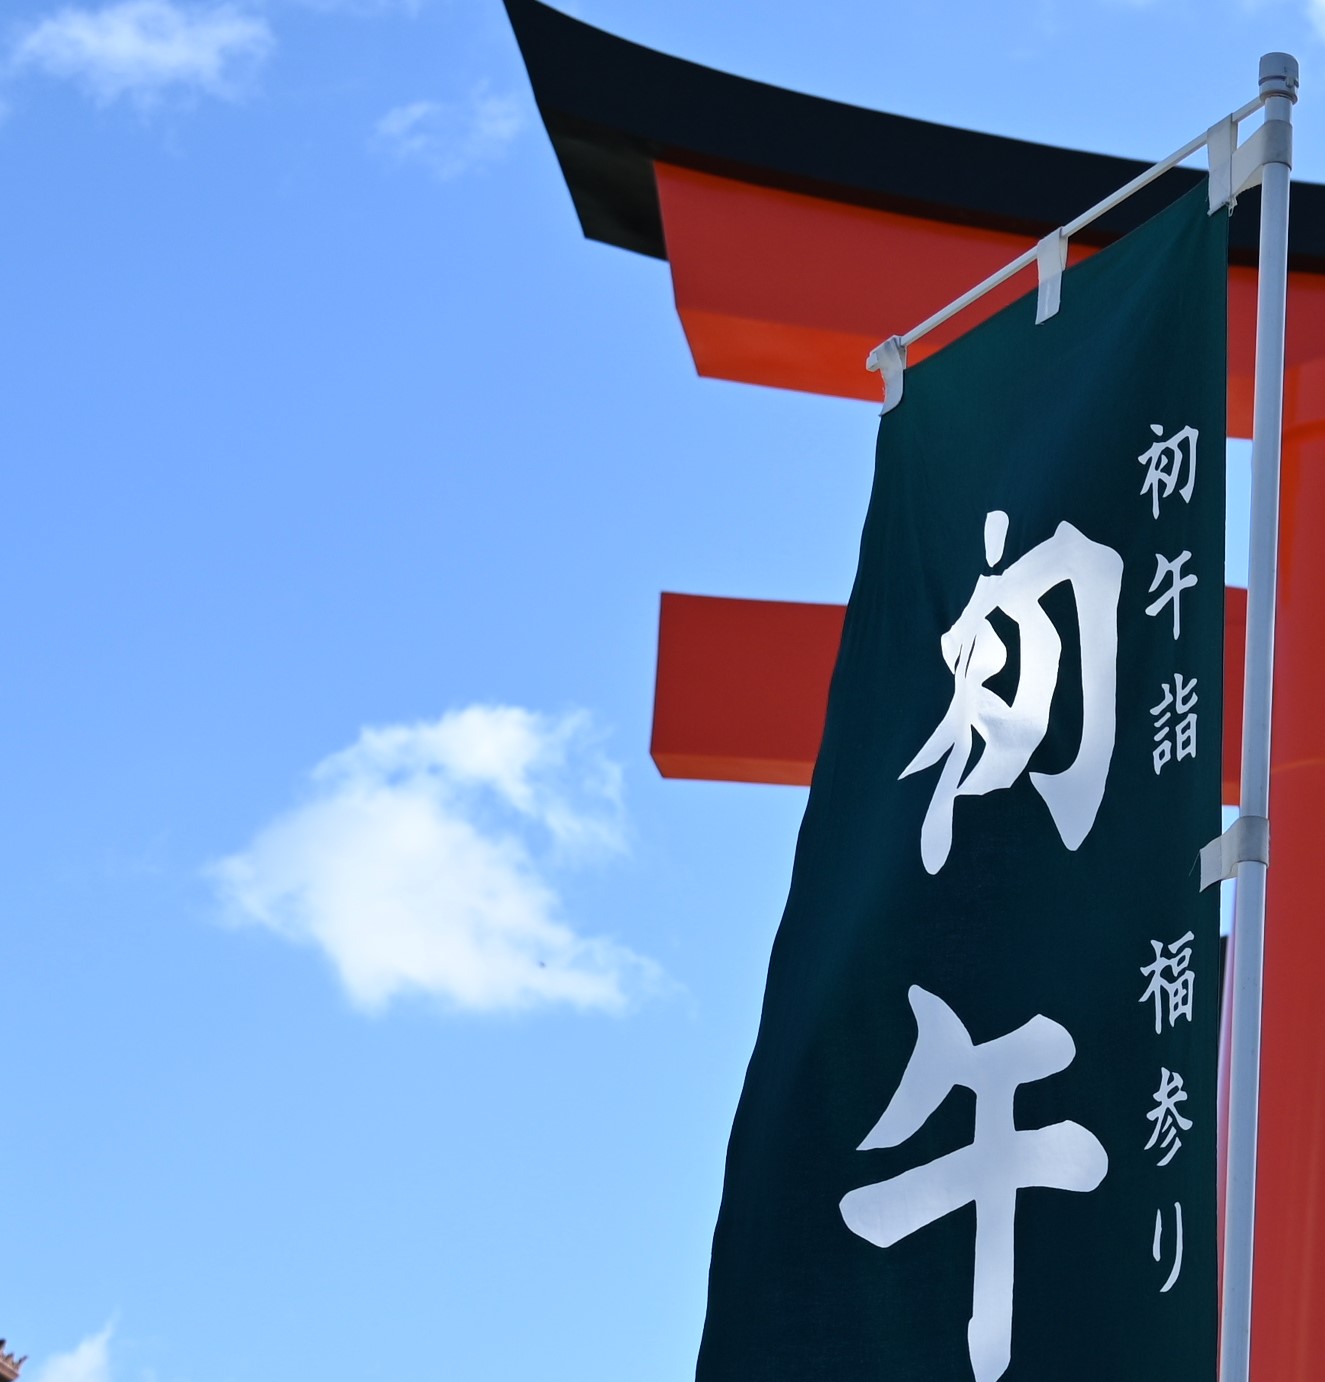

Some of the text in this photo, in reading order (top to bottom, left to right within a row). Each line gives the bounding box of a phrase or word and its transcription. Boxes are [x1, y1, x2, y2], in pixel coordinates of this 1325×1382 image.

[1138, 424, 1198, 1293] 初午詣 福参り
